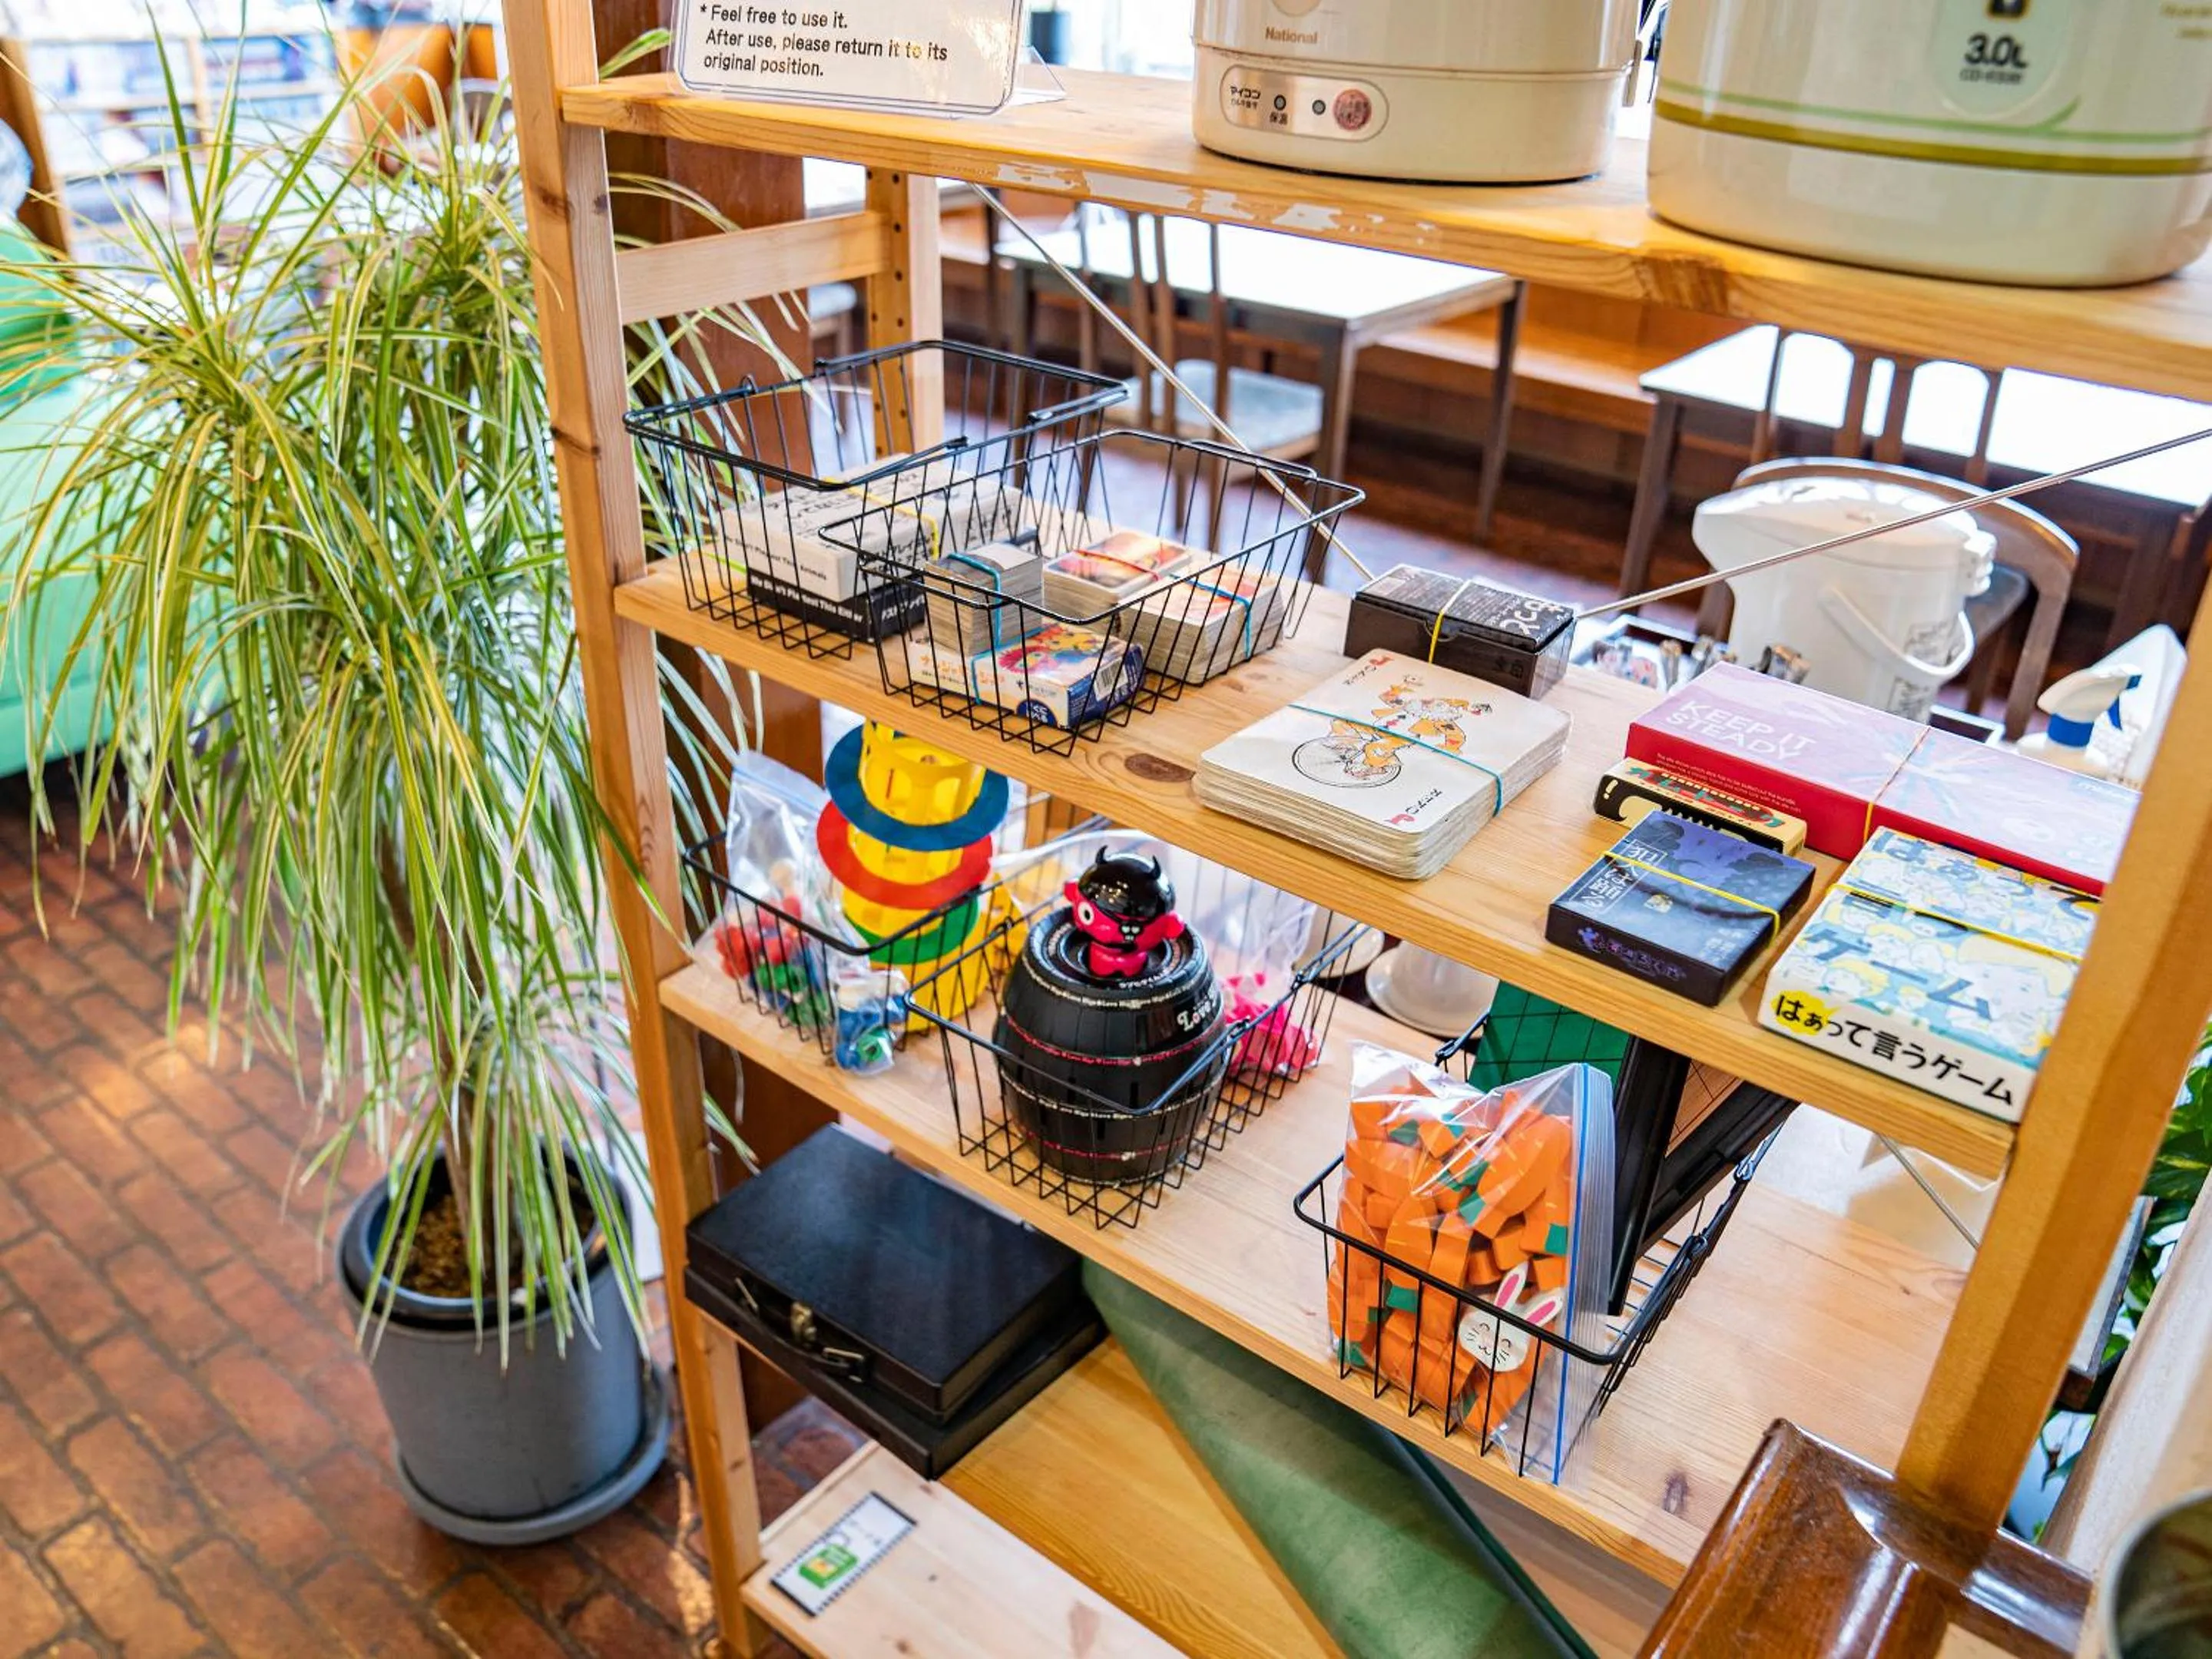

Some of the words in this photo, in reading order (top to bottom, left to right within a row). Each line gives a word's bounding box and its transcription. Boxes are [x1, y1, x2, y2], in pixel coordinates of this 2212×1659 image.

[711, 5, 742, 22] Feel
[747, 7, 777, 24] free
[782, 9, 796, 25] to
[802, 13, 828, 27] use
[833, 12, 847, 28] it.
[1266, 26, 1318, 45] National
[706, 28, 743, 45] After
[748, 35, 777, 51] use,
[783, 33, 830, 52] please
[836, 38, 882, 56] return
[889, 39, 900, 57] it
[906, 41, 922, 58] to
[928, 42, 948, 61] its
[1964, 31, 2029, 69] 3.0L
[704, 52, 756, 71] original
[760, 56, 823, 76] position.
[1665, 711, 1802, 760] STEADY
[1680, 700, 1775, 734] KEEP
[1779, 732, 1817, 750] IT
[1803, 929, 1993, 1022] ゲーム
[1774, 994, 2014, 1106] はぁって言うゲーム
